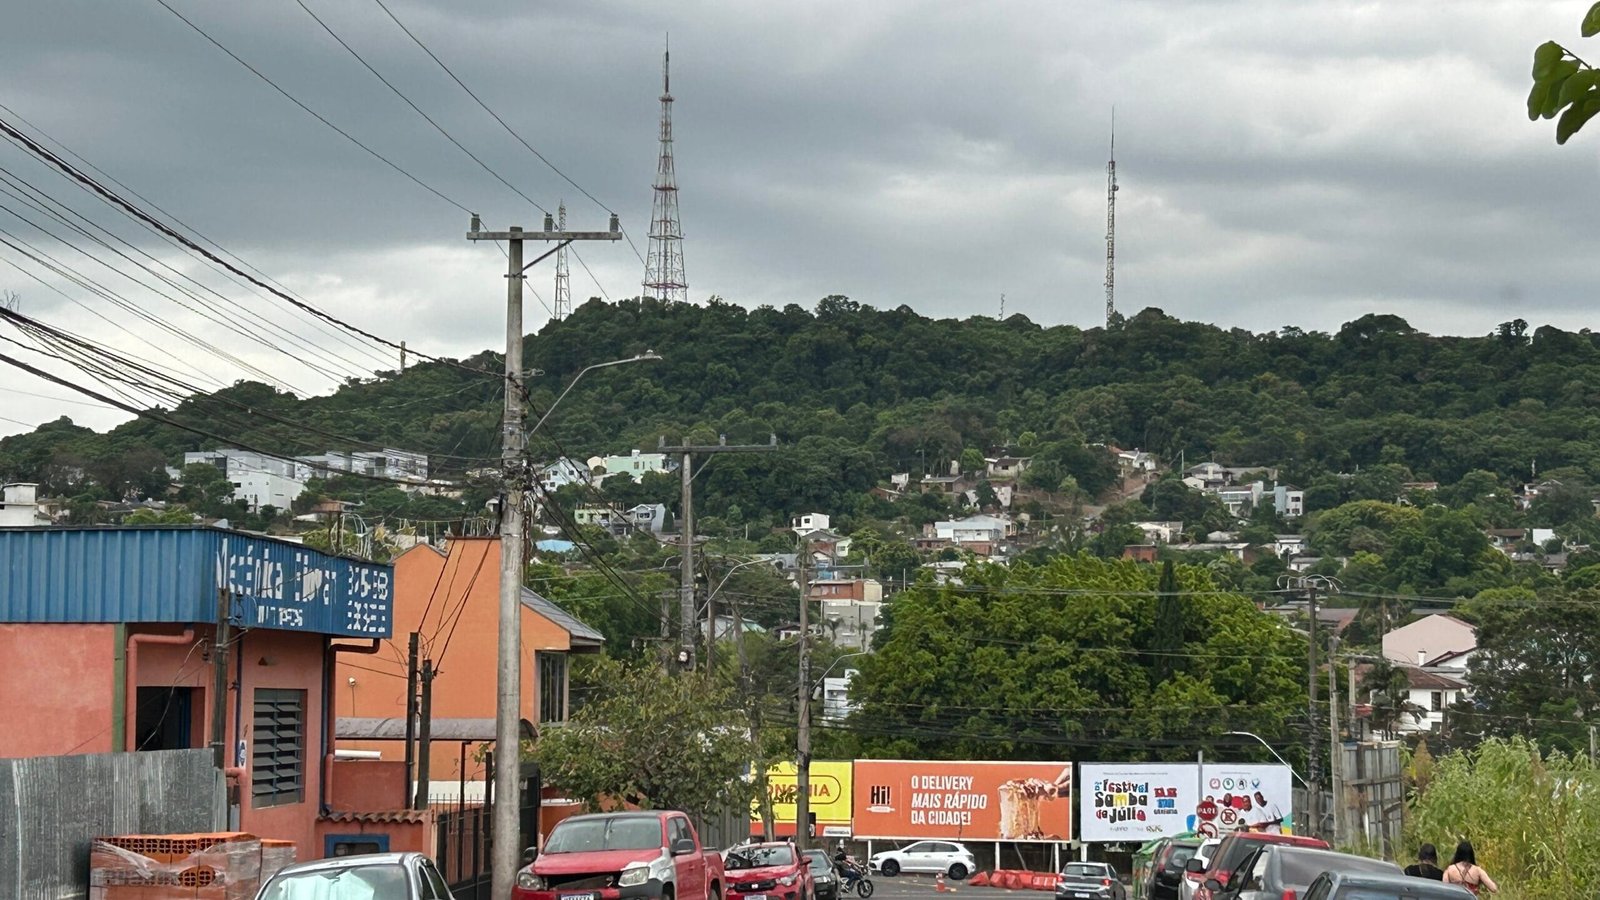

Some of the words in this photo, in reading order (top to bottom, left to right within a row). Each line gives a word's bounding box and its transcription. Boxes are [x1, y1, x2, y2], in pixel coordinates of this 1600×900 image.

[911, 775, 919, 789] O
[921, 776, 974, 791] DELIVERY
[870, 785, 891, 805] Hi!
[911, 793, 941, 809] MAIS
[943, 791, 988, 810] RÁPIDO
[1095, 791, 1148, 808] Samba
[911, 811, 926, 825] DA
[928, 811, 971, 826] CIDADE!
